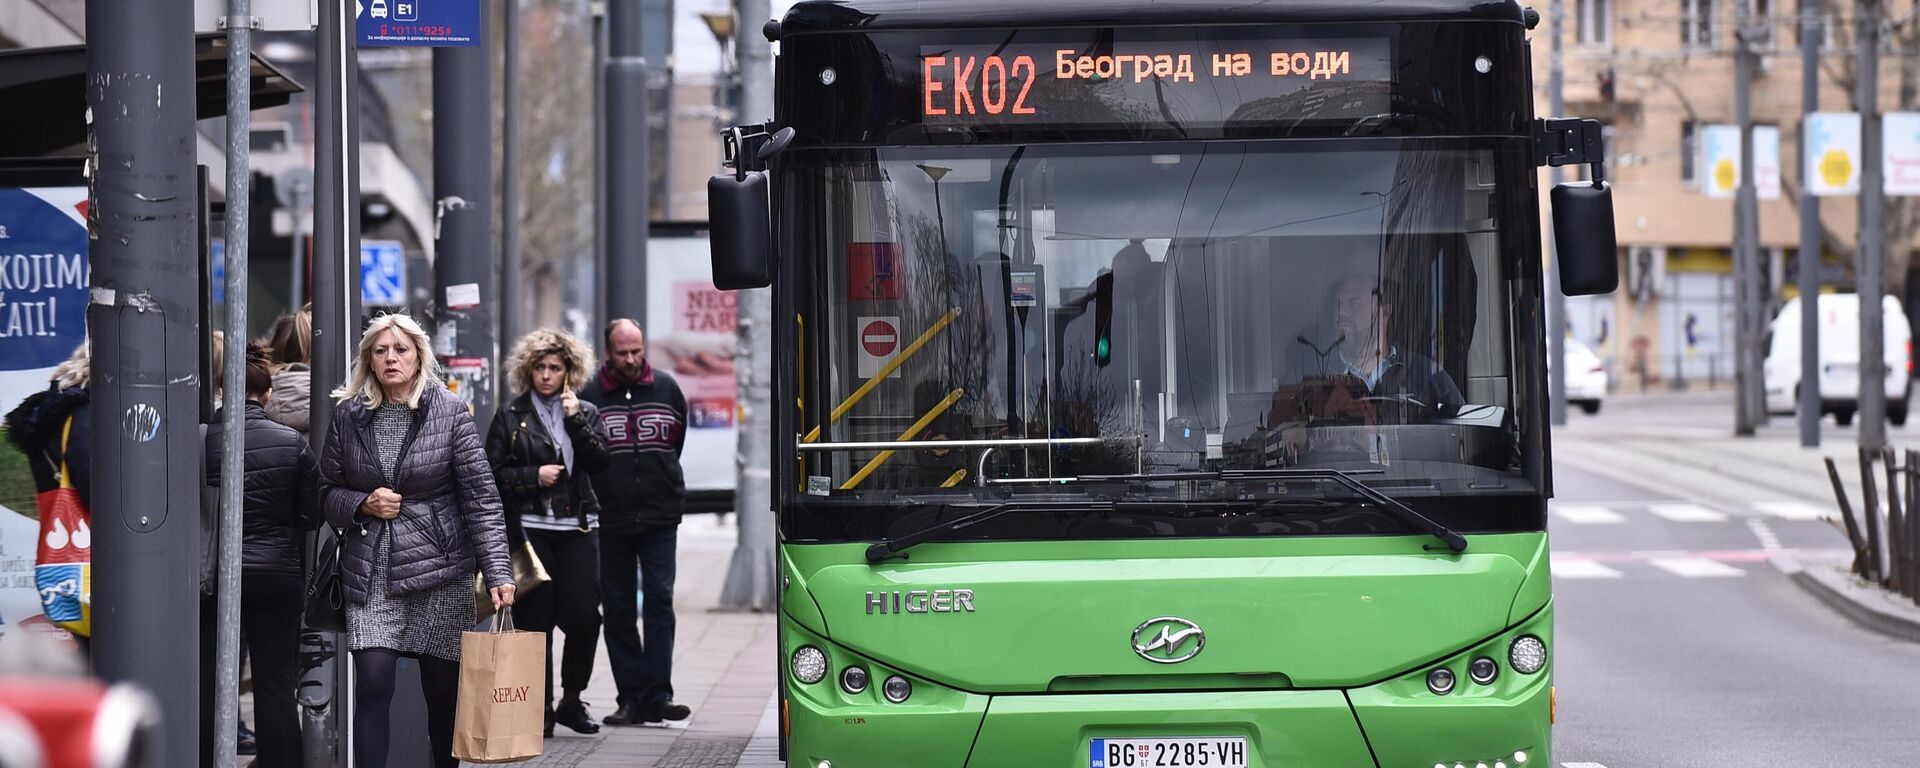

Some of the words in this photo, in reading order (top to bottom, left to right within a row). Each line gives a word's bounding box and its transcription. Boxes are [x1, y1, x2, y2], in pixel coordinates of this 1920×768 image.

[398, 4, 412, 15] E1
[1056, 49, 1194, 83] Београд
[1212, 53, 1251, 77] на
[1271, 51, 1350, 80] води
[0, 253, 89, 293] KOJIM
[865, 589, 976, 614] HIGER
[491, 686, 530, 703] REPLAY
[1108, 743, 1135, 767] BG
